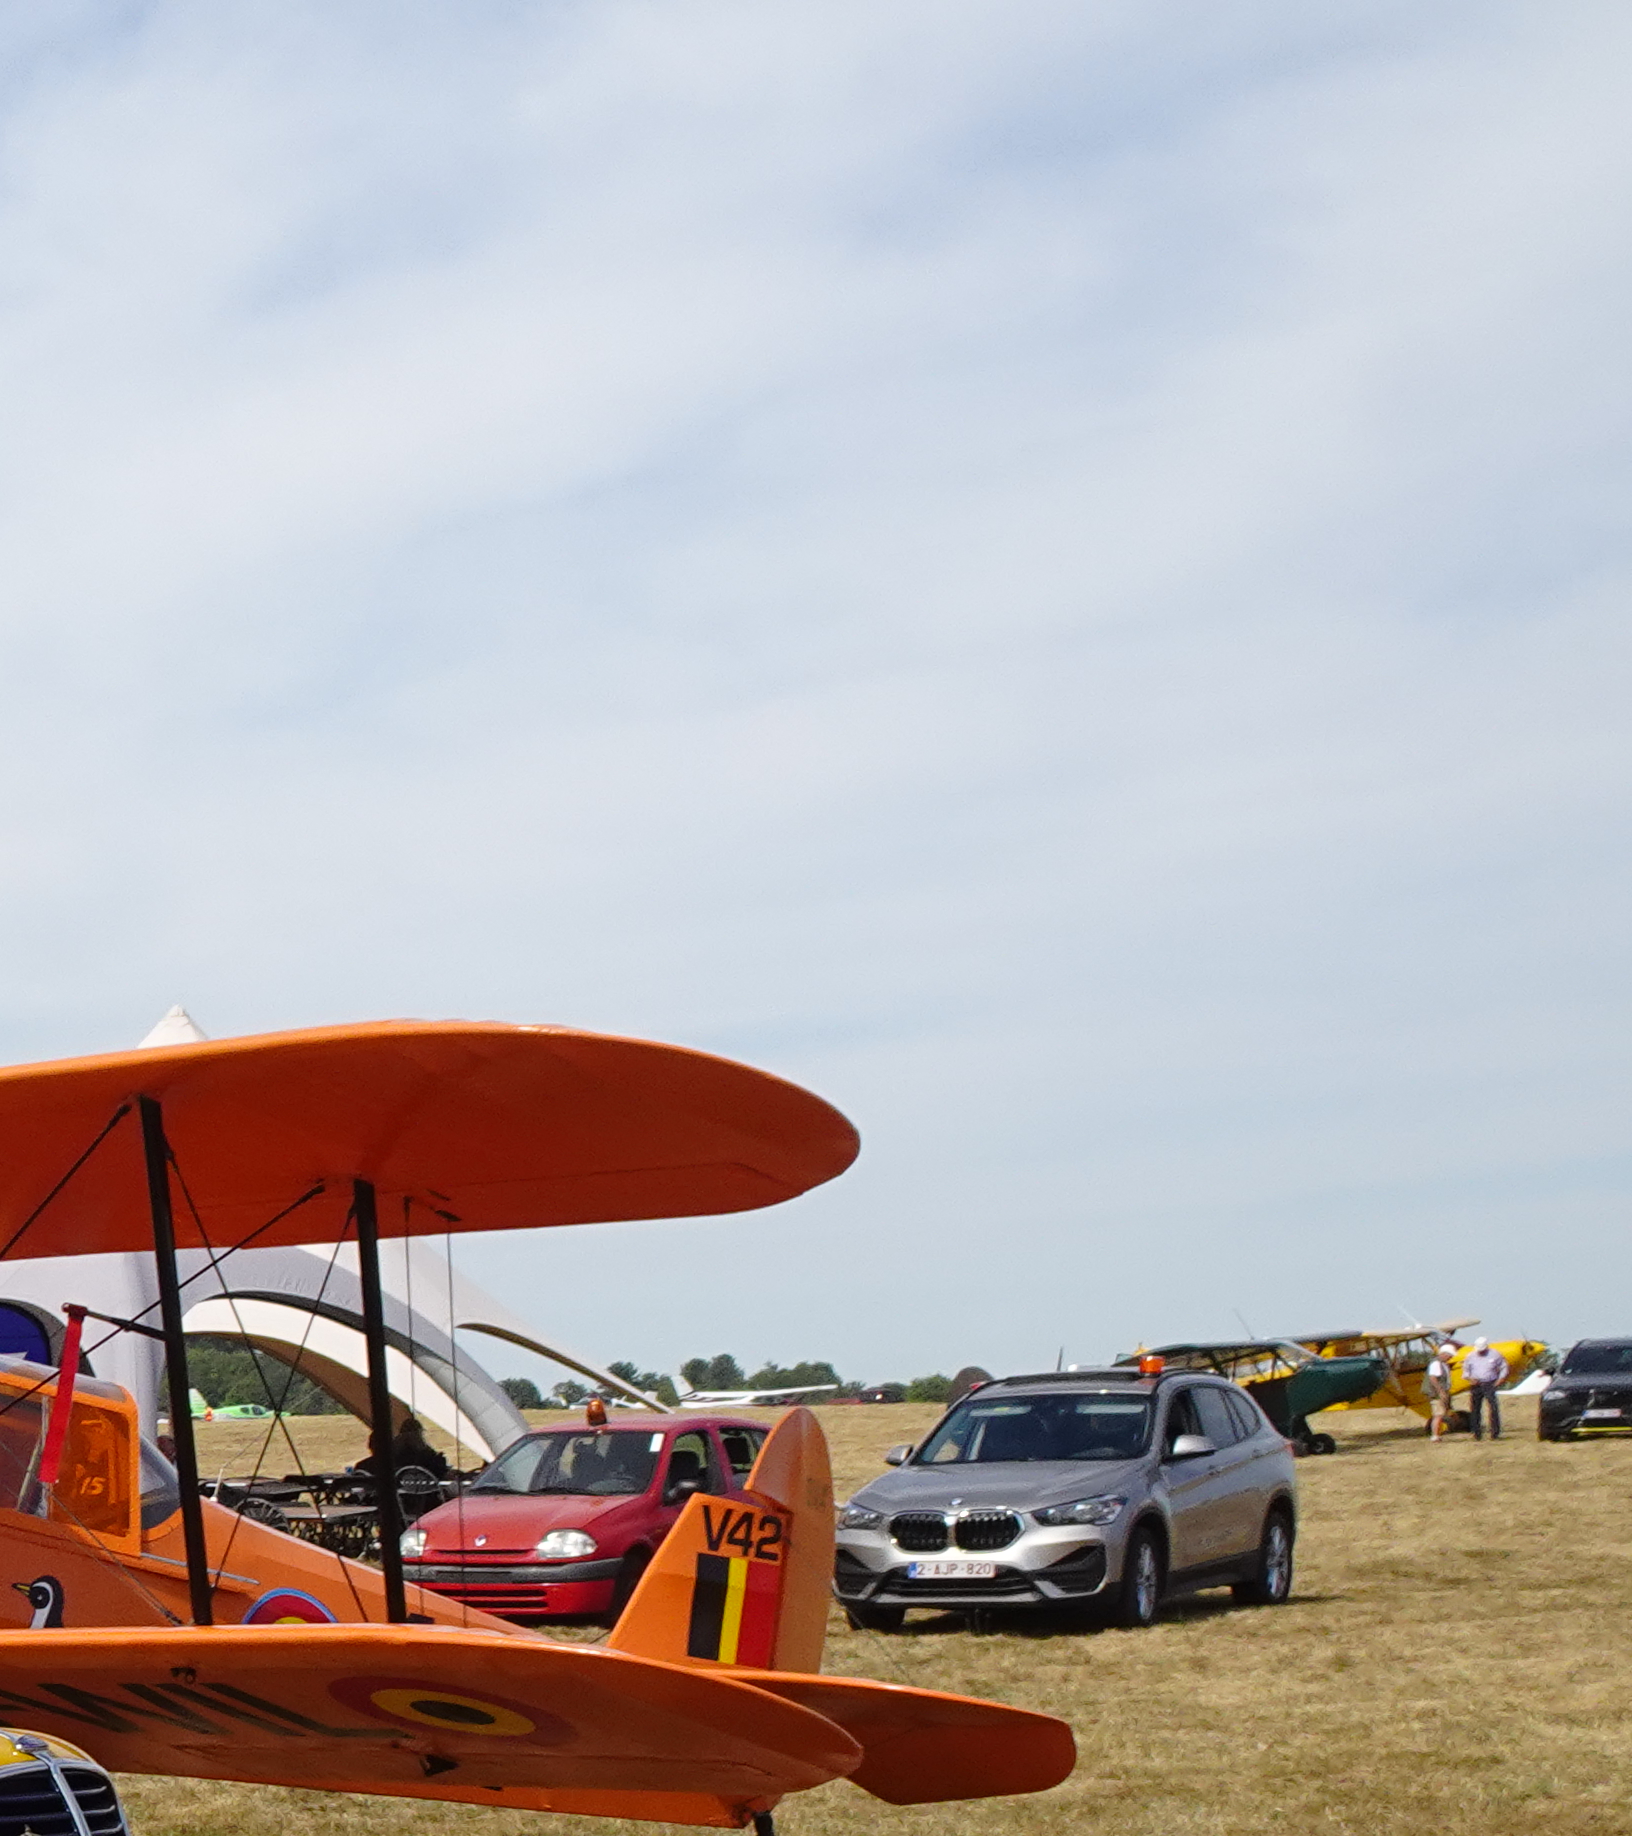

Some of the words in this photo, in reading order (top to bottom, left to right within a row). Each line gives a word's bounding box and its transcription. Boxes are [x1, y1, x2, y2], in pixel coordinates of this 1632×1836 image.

[79, 1476, 107, 1496] 15
[701, 1504, 783, 1561] V42
[916, 1563, 992, 1576] 2-AJP-820
